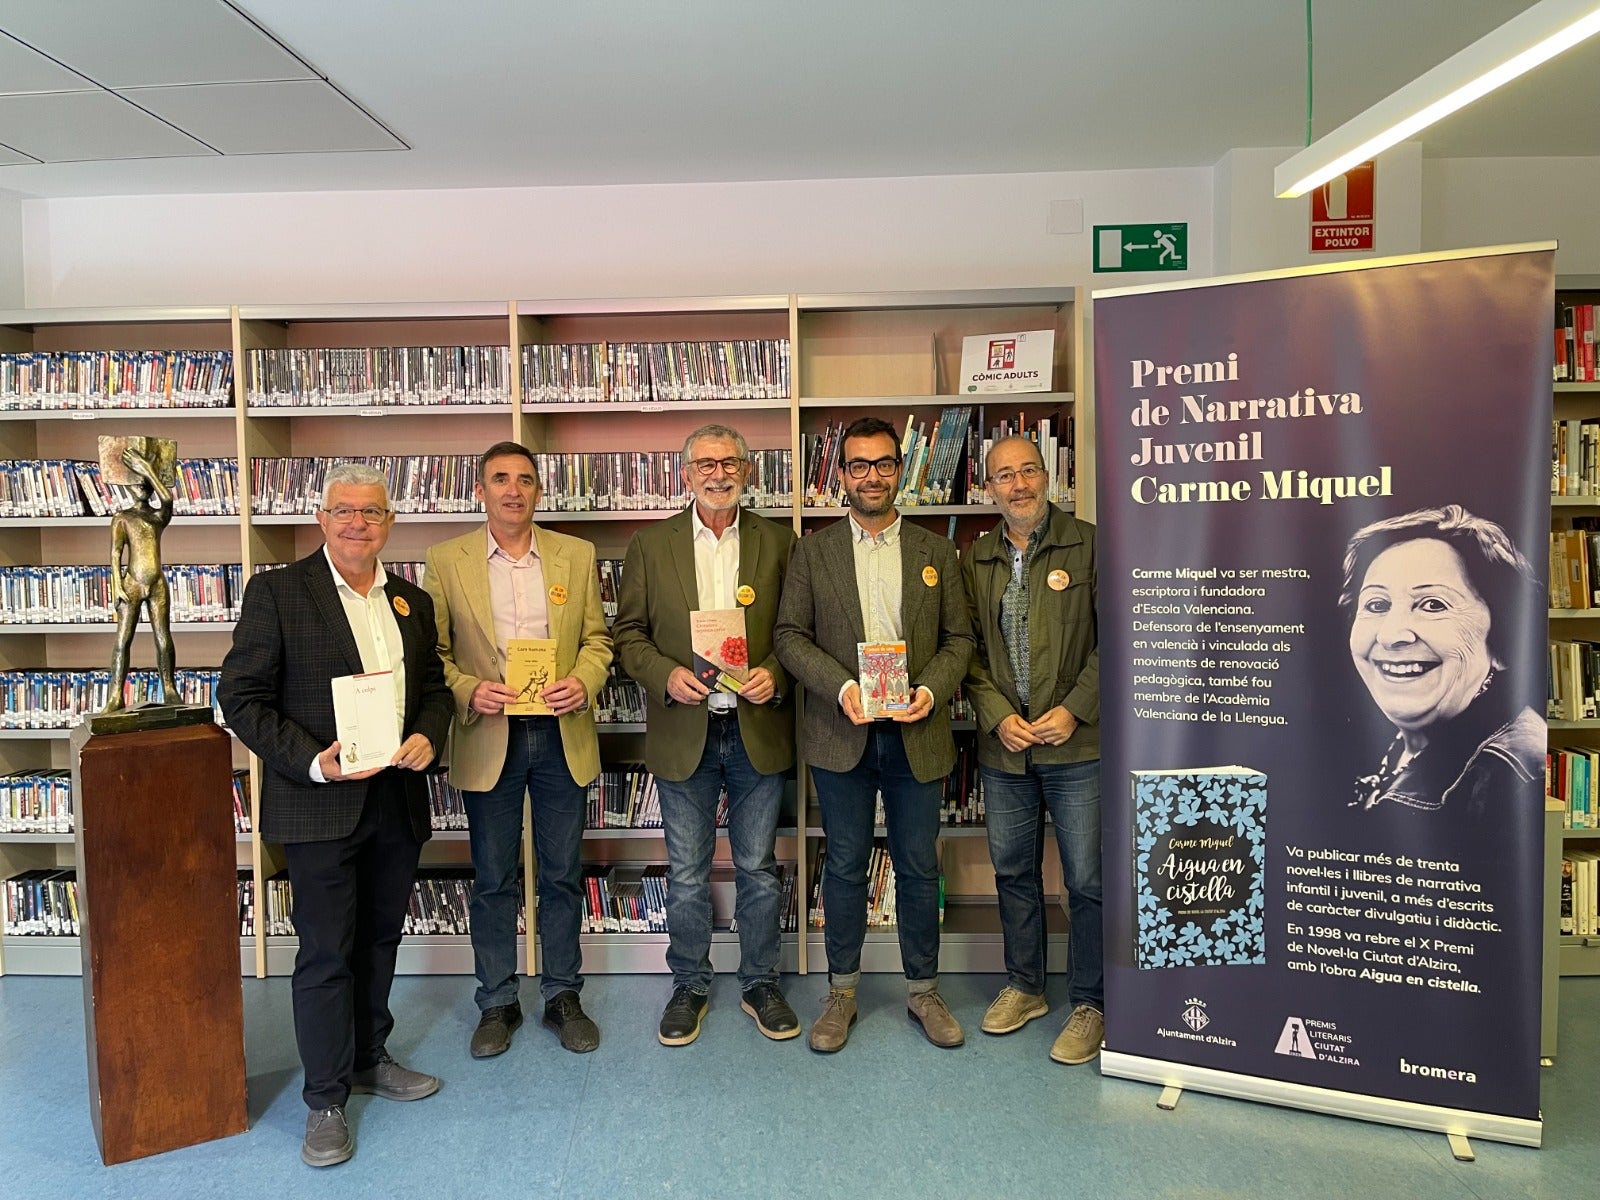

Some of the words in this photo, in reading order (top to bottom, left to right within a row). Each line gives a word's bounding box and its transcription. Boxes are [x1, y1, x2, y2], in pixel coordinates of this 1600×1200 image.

[1315, 227, 1369, 237] EXTINTOR
[1325, 238, 1359, 247] POLVO
[972, 373, 1002, 381] CÒMIC
[1003, 371, 1039, 380] ADULTS
[1130, 352, 1239, 388] Premi
[1131, 398, 1169, 426] de
[1180, 387, 1363, 425] Narrativa
[1130, 431, 1263, 466] Juvenil
[1131, 475, 1251, 505] Carme
[1259, 466, 1394, 505] Miquel
[1132, 568, 1172, 579] Carme
[1176, 568, 1216, 581] Miquel
[1220, 570, 1235, 578] va
[1239, 569, 1258, 578] ser
[1262, 567, 1311, 580] mestra,
[1132, 586, 1190, 598] escriptora
[1193, 586, 1197, 596] i
[1200, 585, 1266, 597] fundadora
[1132, 603, 1180, 614] d'Escola
[1184, 604, 1254, 615] Valenciana.
[1133, 620, 1192, 632] Defensora
[1196, 622, 1211, 632] de
[1215, 621, 1305, 635] l'ensenyament
[1133, 640, 1147, 649] en
[1151, 639, 1198, 650] valencià
[1202, 640, 1206, 650] i
[1209, 640, 1268, 651] vinculada
[1272, 641, 1291, 652] als
[1133, 657, 1197, 668] moviments
[1200, 658, 1215, 668] de
[1219, 658, 1280, 670] renovació
[1133, 674, 1205, 688] pedagògica,
[1208, 676, 1248, 686] també
[1252, 676, 1272, 687] fou
[1134, 691, 1181, 702] membre
[1185, 693, 1200, 703] de
[1203, 693, 1270, 706] l'Acadèmia
[1134, 708, 1198, 721] Valenciana
[1201, 711, 1216, 722] de
[1220, 711, 1231, 722] la
[1236, 712, 1288, 726] Llengua.
[1169, 837, 1197, 850] Carme
[1199, 835, 1234, 850] Miquel
[1286, 845, 1304, 858] Va
[1307, 848, 1360, 863] publicar
[1364, 852, 1392, 865] més
[1396, 855, 1413, 867] de
[1417, 858, 1459, 872] trenta
[1157, 853, 1220, 881] Aigua
[1221, 857, 1245, 875] en
[1287, 865, 1341, 879] novel·les
[1345, 868, 1349, 879] i
[1353, 869, 1392, 883] llibres
[1396, 874, 1413, 886] de
[1417, 877, 1481, 893] narrativa
[1166, 875, 1235, 905] cistella
[1287, 882, 1330, 896] infantil
[1334, 885, 1338, 897] i
[1340, 886, 1387, 903] juvenil,
[1391, 893, 1400, 903] a
[1404, 894, 1433, 907] més
[1437, 897, 1494, 912] d'escrits
[1287, 899, 1302, 911] de
[1306, 901, 1361, 917] caràcter
[1364, 906, 1432, 925] divulgatiu
[1435, 915, 1439, 926] i
[1443, 916, 1502, 932] didàctic.
[1287, 923, 1303, 935] En
[1308, 925, 1341, 939] 1998
[1345, 931, 1361, 942] va
[1365, 932, 1400, 946] rebre
[1404, 936, 1416, 948] el
[1419, 937, 1430, 950] X
[1434, 939, 1474, 955] Premi
[1287, 941, 1303, 953] de
[1307, 943, 1359, 960] Novel·la
[1363, 949, 1404, 966] Ciutat
[1407, 956, 1461, 973] d'Alzira,
[1288, 959, 1317, 972] amb
[1320, 963, 1356, 978] l'obra
[1359, 967, 1402, 984] Aigua
[1406, 975, 1423, 986] en
[1427, 977, 1481, 993] cistella.
[1305, 1019, 1337, 1030] PREMIS
[1157, 1027, 1204, 1042] Ajuntament
[1205, 1035, 1237, 1047] d'Alzira
[1309, 1030, 1352, 1043] LITERARIS
[1314, 1042, 1345, 1053] CIUTAT
[1318, 1053, 1360, 1066] D'ALZIRA
[1400, 1058, 1477, 1083] bromera
